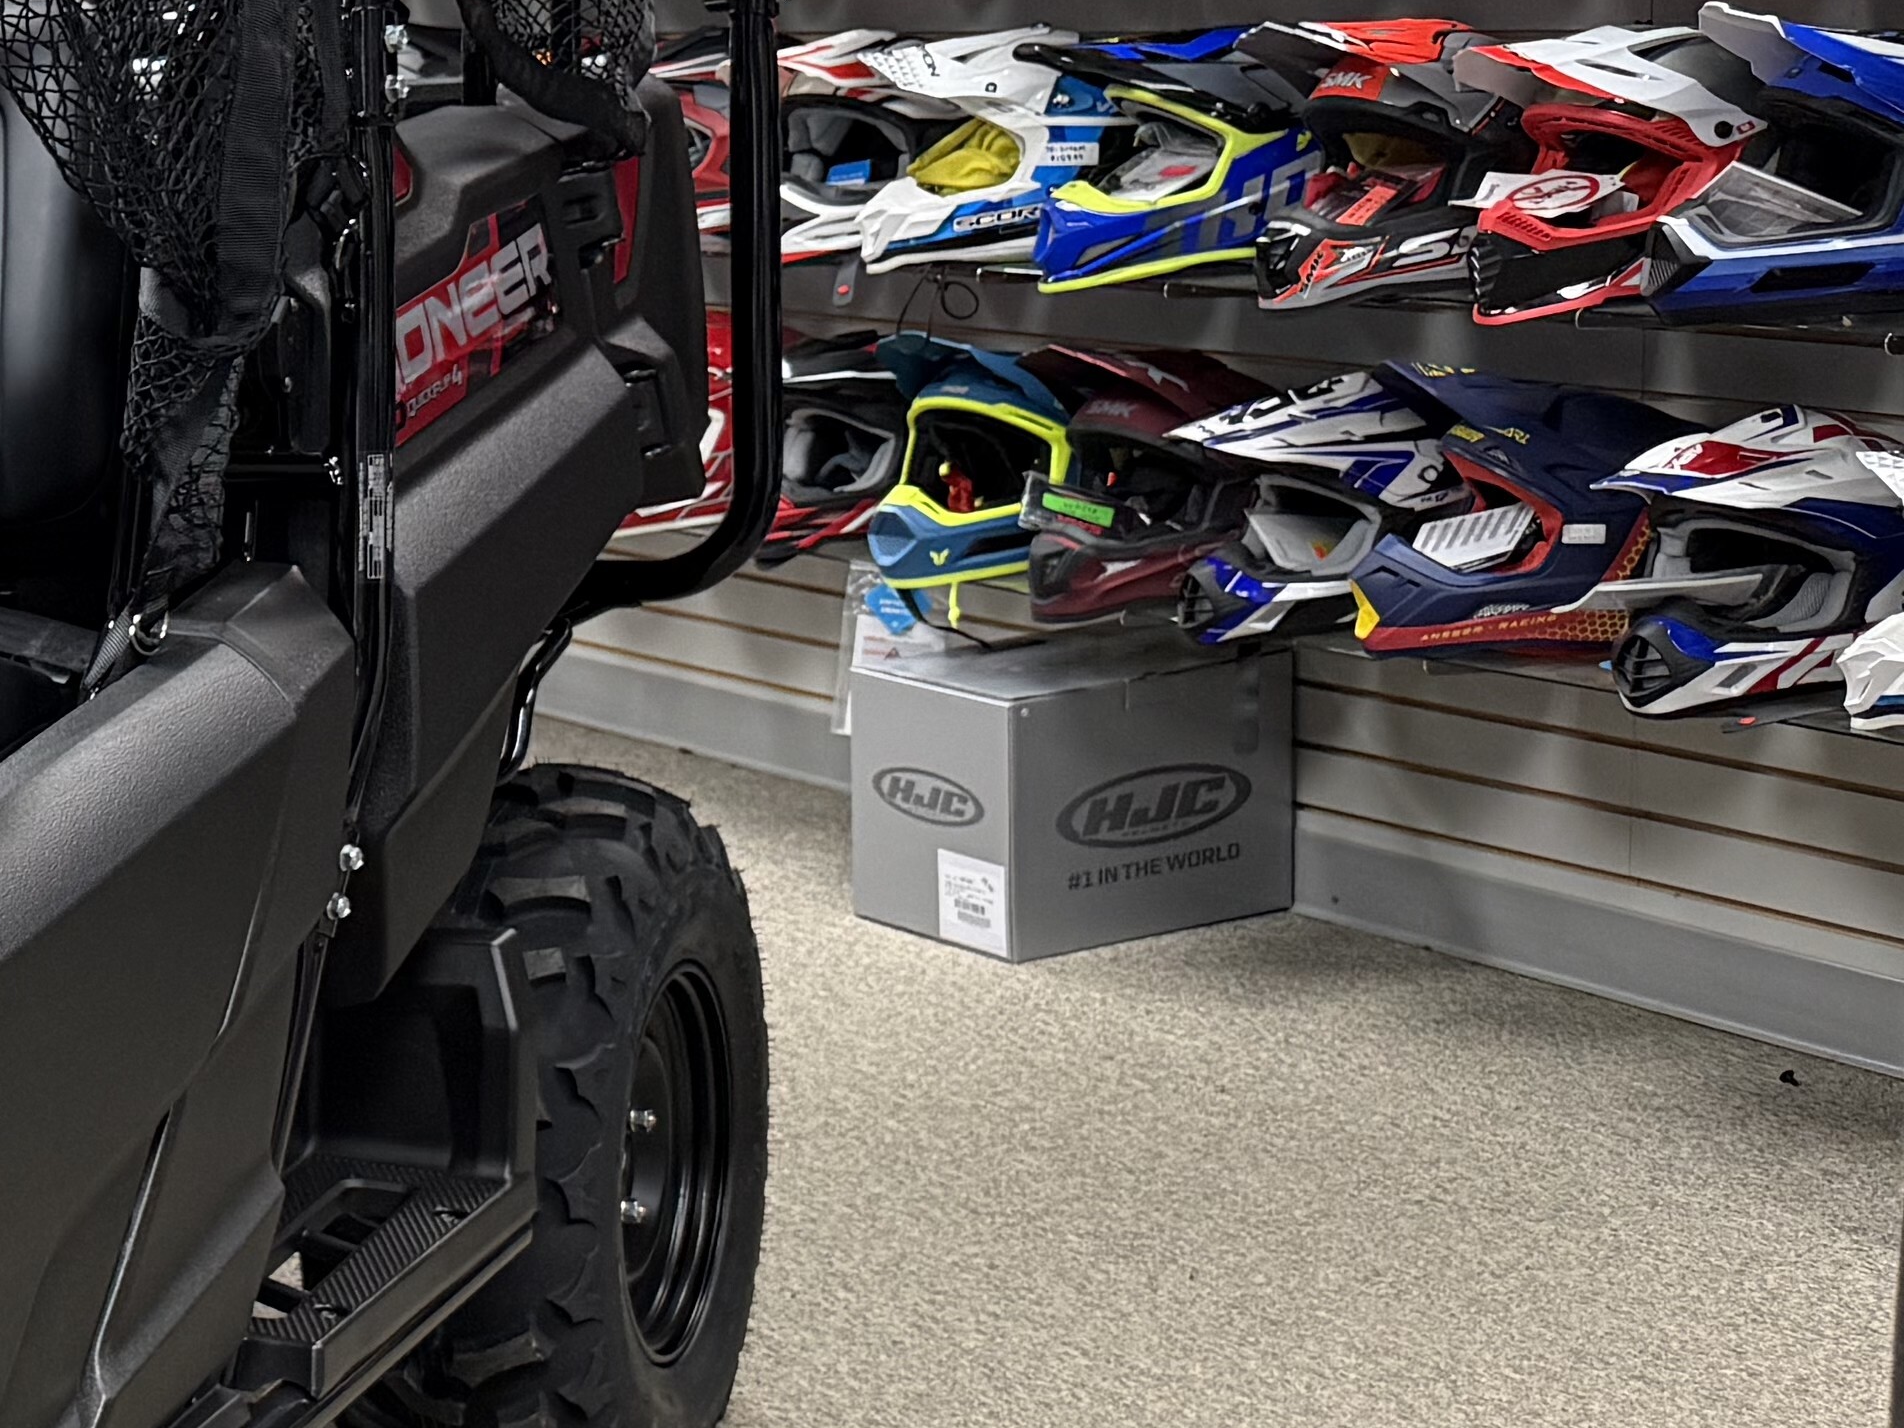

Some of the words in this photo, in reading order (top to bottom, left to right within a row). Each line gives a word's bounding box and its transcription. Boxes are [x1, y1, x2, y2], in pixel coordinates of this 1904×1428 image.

[1321, 72, 1366, 90] SMK
[955, 206, 1042, 232] SCOR
[395, 223, 552, 392] ONEER
[887, 775, 969, 818] HJC
[1082, 775, 1227, 837] HJC
[1068, 871, 1093, 890] #1
[1098, 866, 1118, 885] IN
[1122, 857, 1162, 880] THE
[1166, 842, 1240, 871] WORLD
